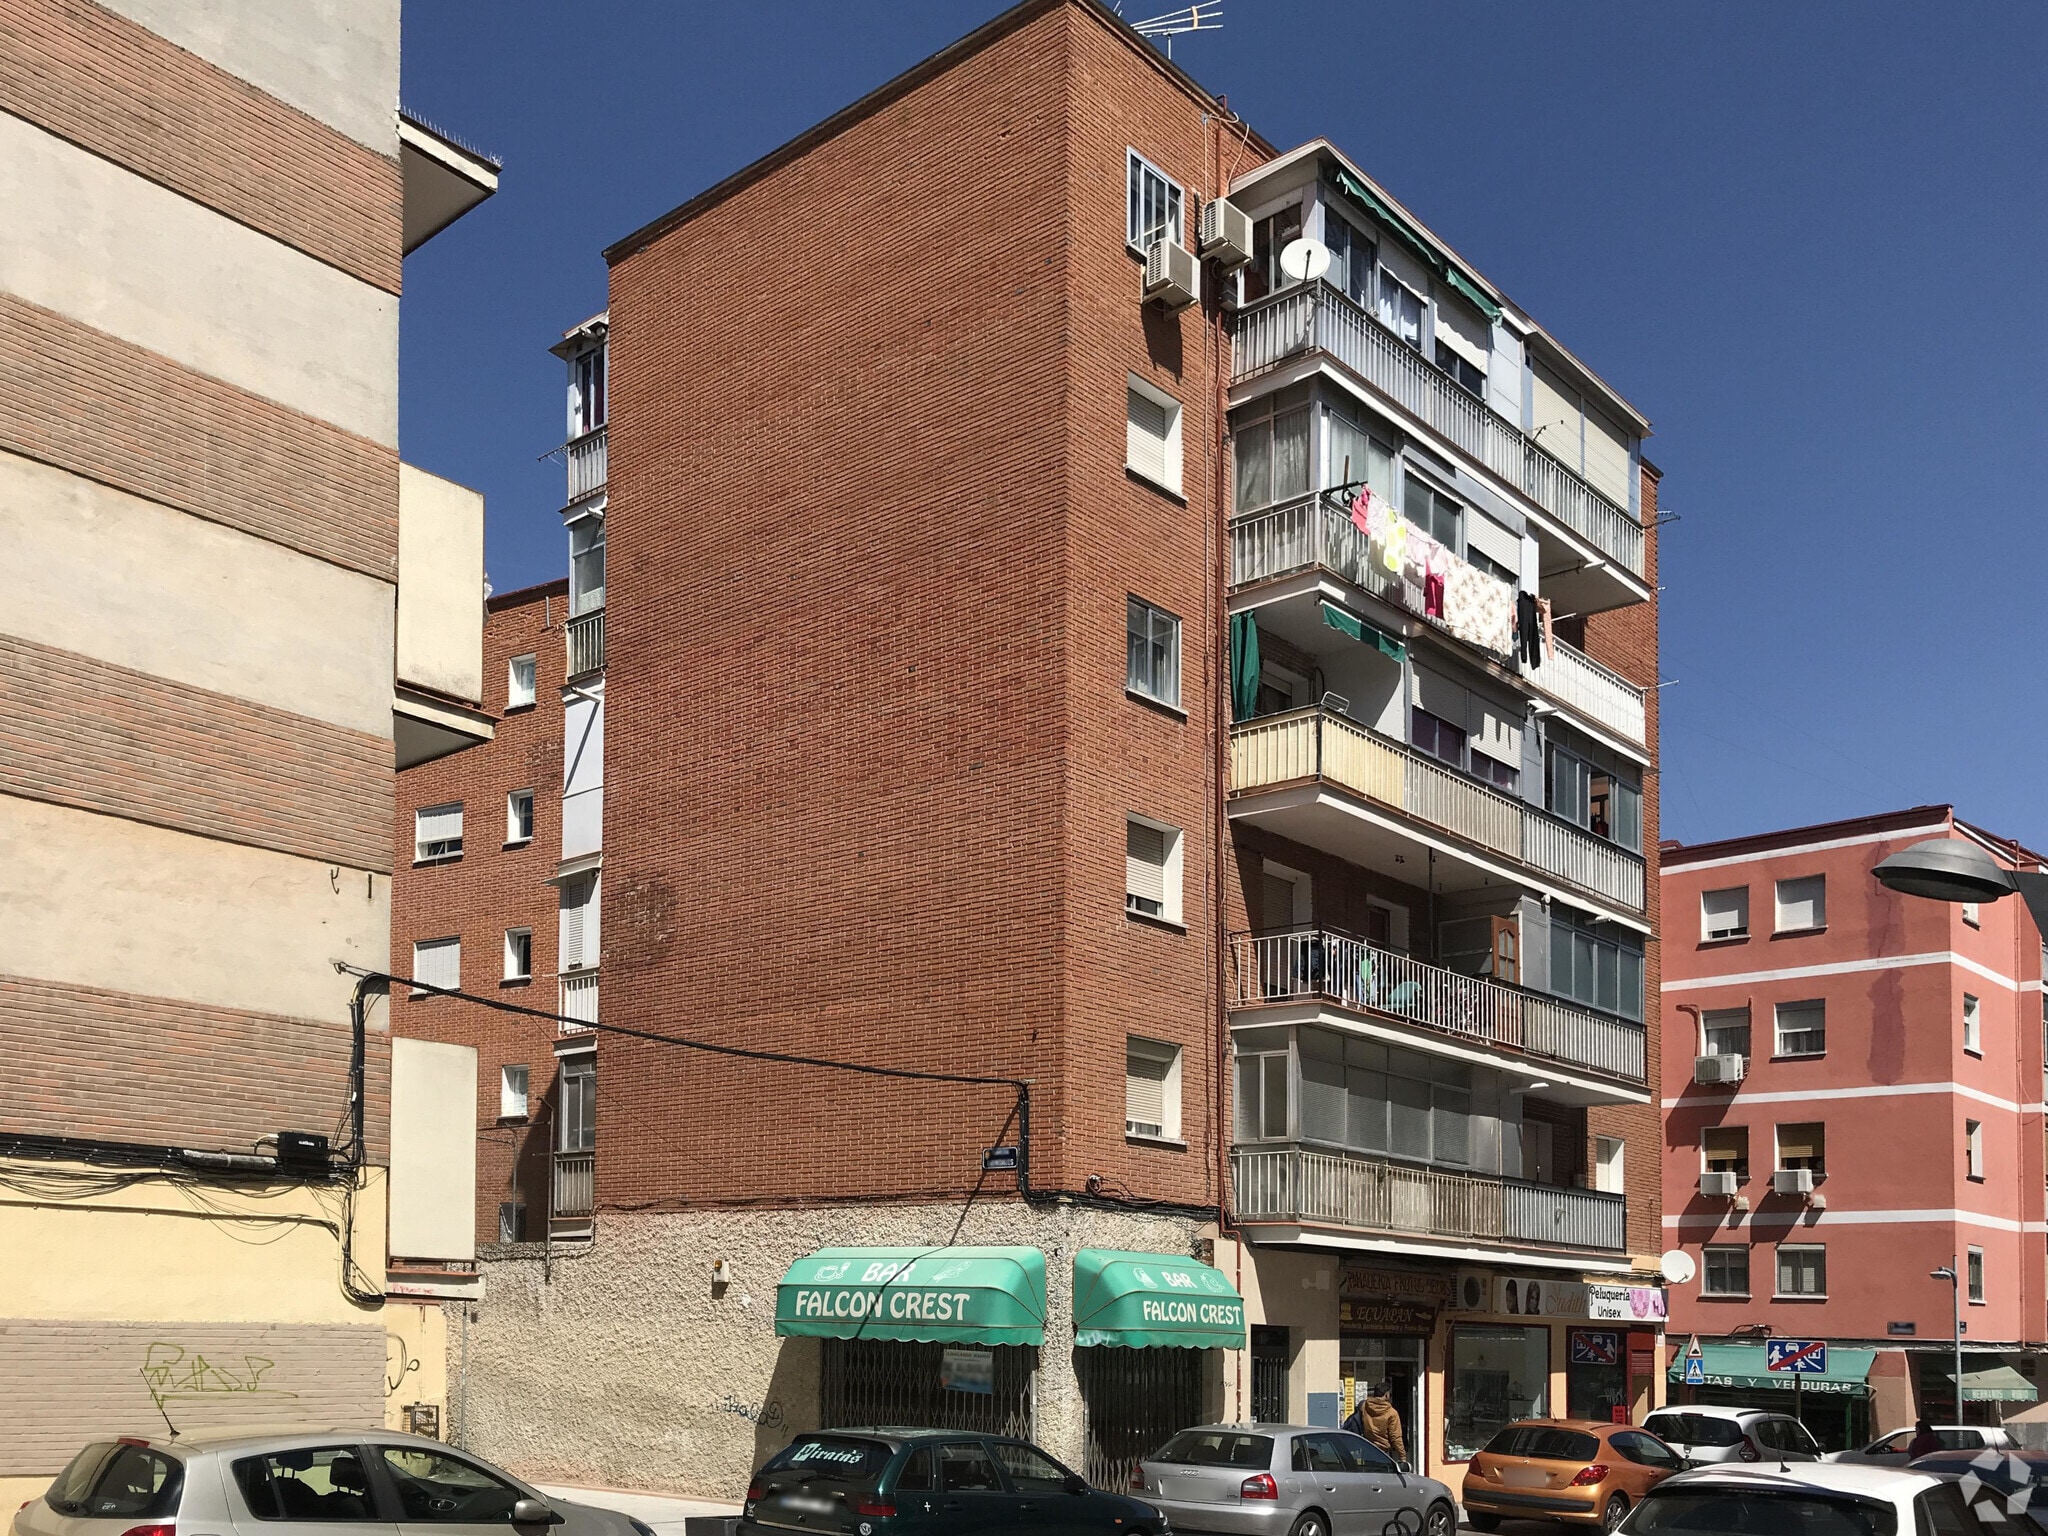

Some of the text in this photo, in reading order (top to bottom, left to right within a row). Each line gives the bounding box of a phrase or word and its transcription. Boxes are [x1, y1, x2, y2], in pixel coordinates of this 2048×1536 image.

[861, 1262, 916, 1282] BAR
[1161, 1271, 1198, 1288] BAR
[795, 1290, 970, 1321] FALCON CREST
[1588, 1285, 1630, 1306] Peluquería
[1143, 1301, 1241, 1326] FALCON CREST
[1597, 1306, 1622, 1318] Unisex
[1679, 1373, 1732, 1386] FTAS
[1747, 1378, 1759, 1387] Y
